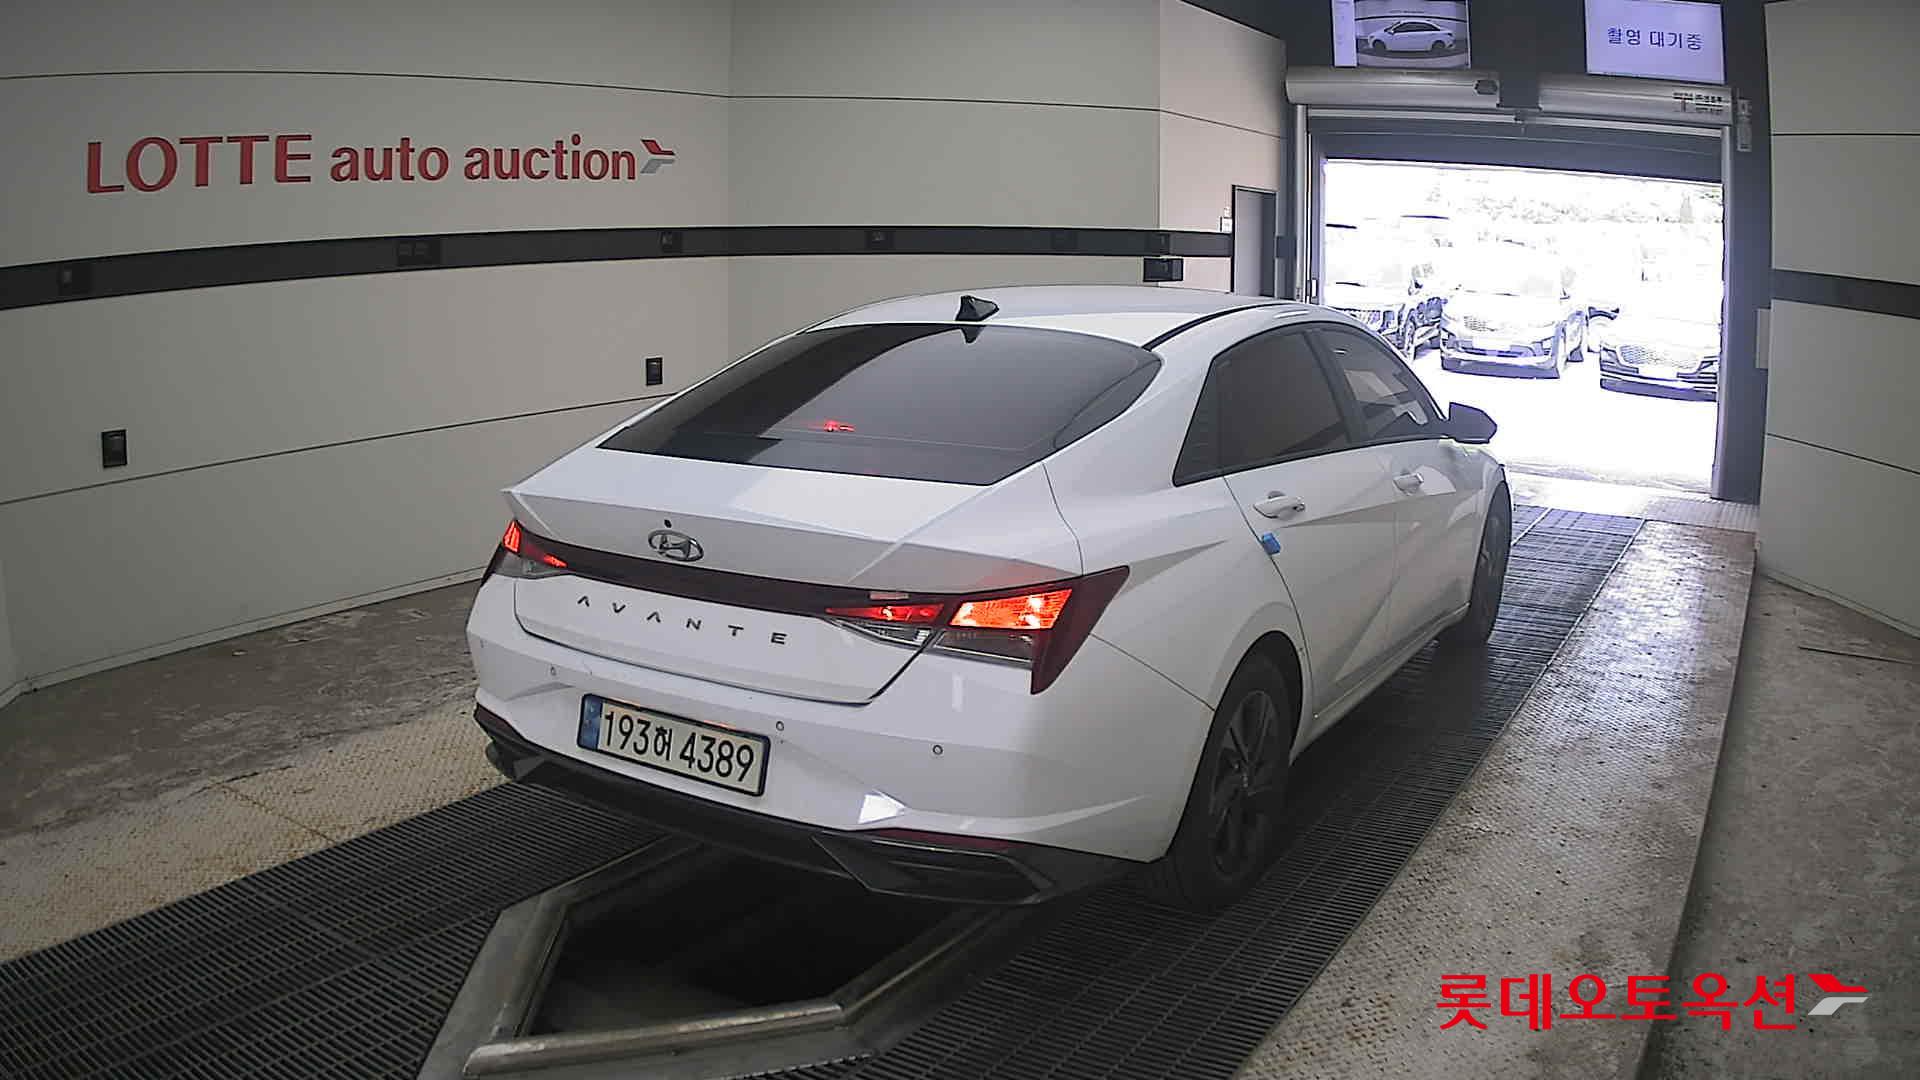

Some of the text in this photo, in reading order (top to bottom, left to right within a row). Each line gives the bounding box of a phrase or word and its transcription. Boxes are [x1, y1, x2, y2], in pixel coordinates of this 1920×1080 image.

[1649, 31, 1702, 50] 대기중
[86, 133, 637, 195] LOTTE auto auction
[576, 594, 788, 645] AVANTE
[604, 710, 755, 783] 193허 4389
